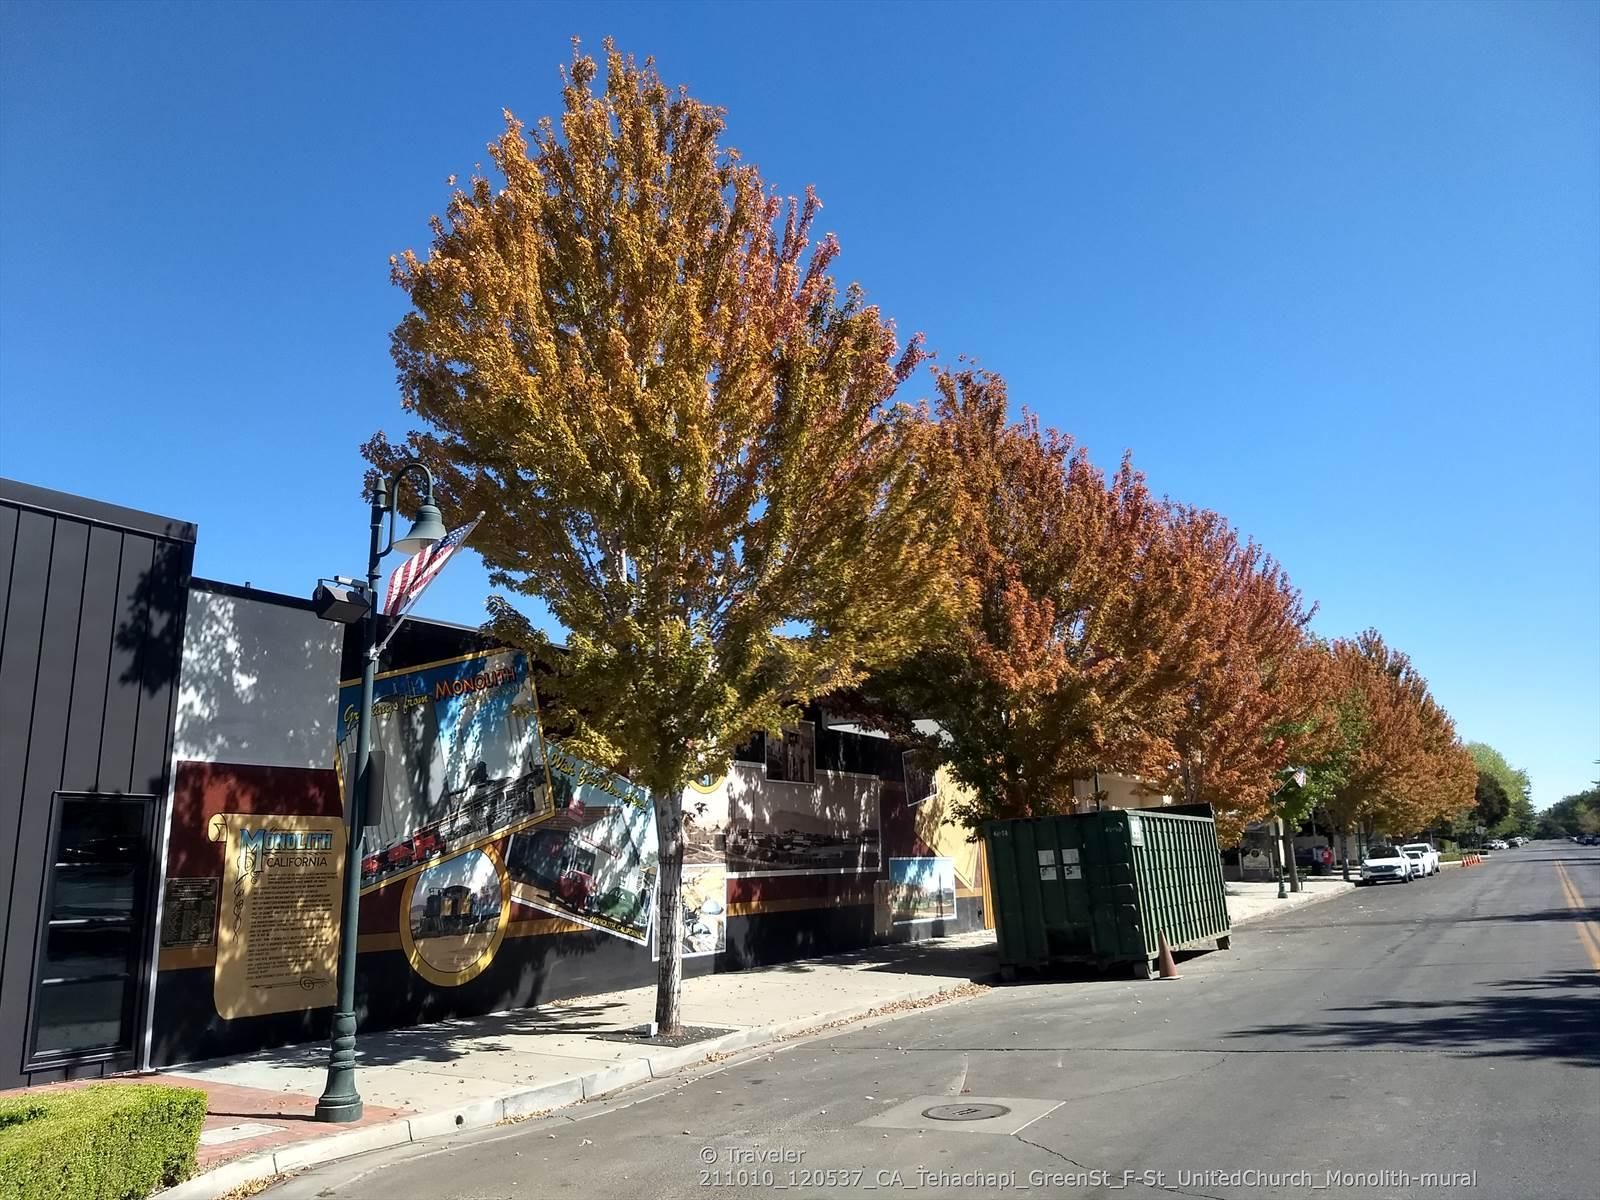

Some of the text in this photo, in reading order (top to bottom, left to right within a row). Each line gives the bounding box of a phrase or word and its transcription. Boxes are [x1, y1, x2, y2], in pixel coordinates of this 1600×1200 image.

[344, 701, 400, 730] Grtings
[435, 667, 517, 702] MONOLITH
[239, 828, 333, 875] MONOLITH
[266, 857, 328, 868] CALIFORNIA
